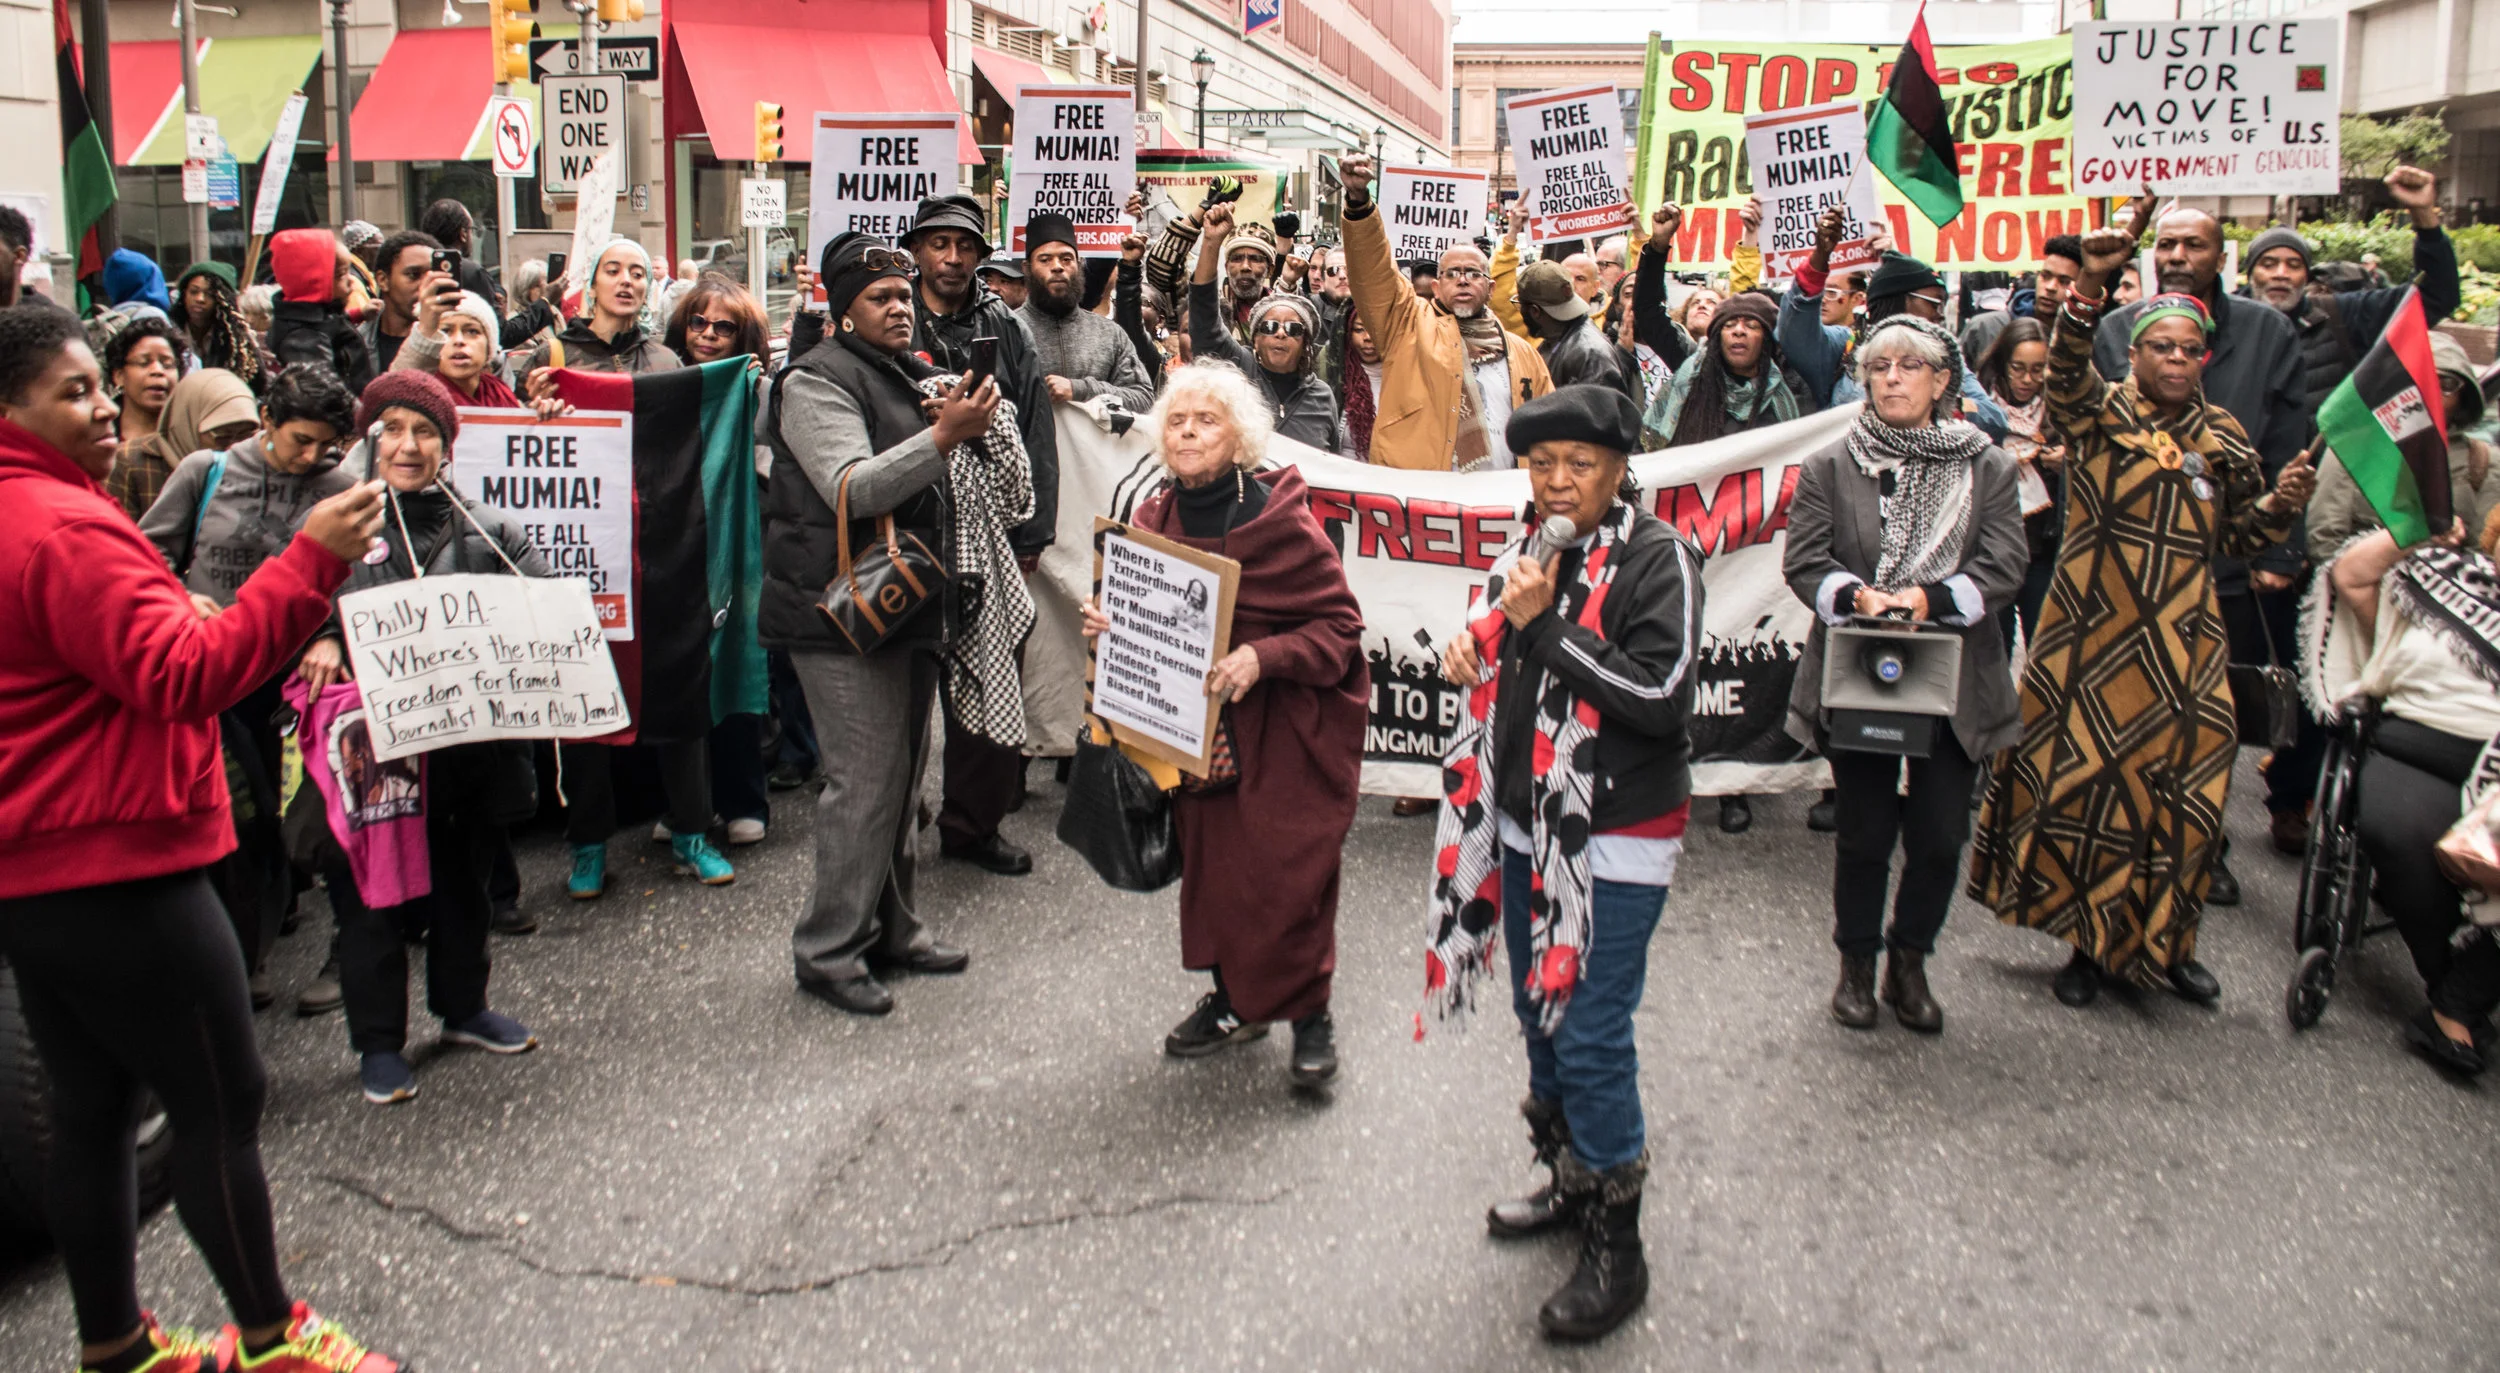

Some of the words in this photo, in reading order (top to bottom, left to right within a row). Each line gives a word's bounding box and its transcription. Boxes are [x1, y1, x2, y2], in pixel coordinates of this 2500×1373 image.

[2097, 23, 2298, 65] JUSTICE
[609, 50, 645, 68] WAY
[1669, 50, 1858, 114] STOP
[2164, 63, 2238, 92] FOR
[559, 88, 609, 114] END
[2103, 95, 2271, 128] MOVE!
[1054, 104, 1105, 130] FREE
[1138, 113, 1160, 123] BLOCK
[1227, 111, 1286, 127] PARK
[1541, 102, 1590, 132] FREE
[560, 122, 609, 147] ONE
[1034, 135, 1120, 162] MUMIA!
[1530, 126, 1609, 161] MUMIA!
[1776, 124, 1830, 156] FREE
[2112, 128, 2210, 150] VICTIMS
[2230, 128, 2259, 144] OF
[2283, 120, 2331, 145] U.S.
[860, 137, 919, 166] FREE
[2082, 153, 2240, 184] GOVERNMENT
[2255, 147, 2331, 174] GENOCIDE
[560, 155, 599, 181] WA
[1043, 172, 1079, 190] FREE
[1083, 172, 1111, 190] ALL
[1145, 176, 1198, 187] POLITICAL
[1545, 165, 1577, 184] FREE
[1582, 160, 1606, 177] ALL
[1766, 151, 1852, 188] MUMIA!
[1953, 137, 2074, 198] FRE
[757, 185, 771, 195] NO
[837, 171, 937, 202] MUMIA!
[1034, 190, 1116, 208] POLITICAL
[1411, 180, 1456, 204] FREE
[1541, 174, 1615, 199] POLITICAL
[745, 209, 759, 219] ON
[763, 209, 783, 220] RED
[750, 197, 778, 207] TURN
[1539, 188, 1621, 216] PRISONERS!
[1778, 194, 1813, 215] FREE
[1819, 190, 1847, 209] ALL
[849, 214, 891, 234] FREE
[1394, 204, 1469, 230] MUMIA!
[1402, 234, 1431, 249] FREE
[1772, 222, 1864, 251] PRISORS!
[506, 434, 577, 469] FREE
[482, 475, 602, 510] MUMIA!
[552, 523, 590, 546] ALL
[1309, 486, 1516, 571] FREE
[210, 546, 255, 567] FREE
[540, 547, 600, 570] TICAL
[1110, 542, 1150, 569] Where
[1153, 559, 1166, 575] is
[880, 583, 907, 614] e
[1107, 592, 1126, 610] For
[1129, 600, 1178, 630] Mumia?
[351, 599, 428, 642] Philly
[1112, 611, 1126, 626] No
[1128, 617, 1181, 650] ballistics
[1183, 639, 1206, 660] test
[370, 641, 479, 679] Where's
[488, 634, 524, 661] the
[1109, 631, 1152, 659] Witness
[1153, 650, 1203, 680] Coercion
[1109, 647, 1158, 677] Evidence
[1102, 658, 1162, 694] Tampering
[367, 681, 462, 723] Freedom
[468, 669, 504, 692] for
[508, 667, 561, 690] framed
[1106, 676, 1144, 702] Biased
[1146, 692, 1179, 717] Judge
[1388, 681, 1428, 721] TO
[383, 705, 477, 746] Journalist
[547, 699, 577, 725] Abu
